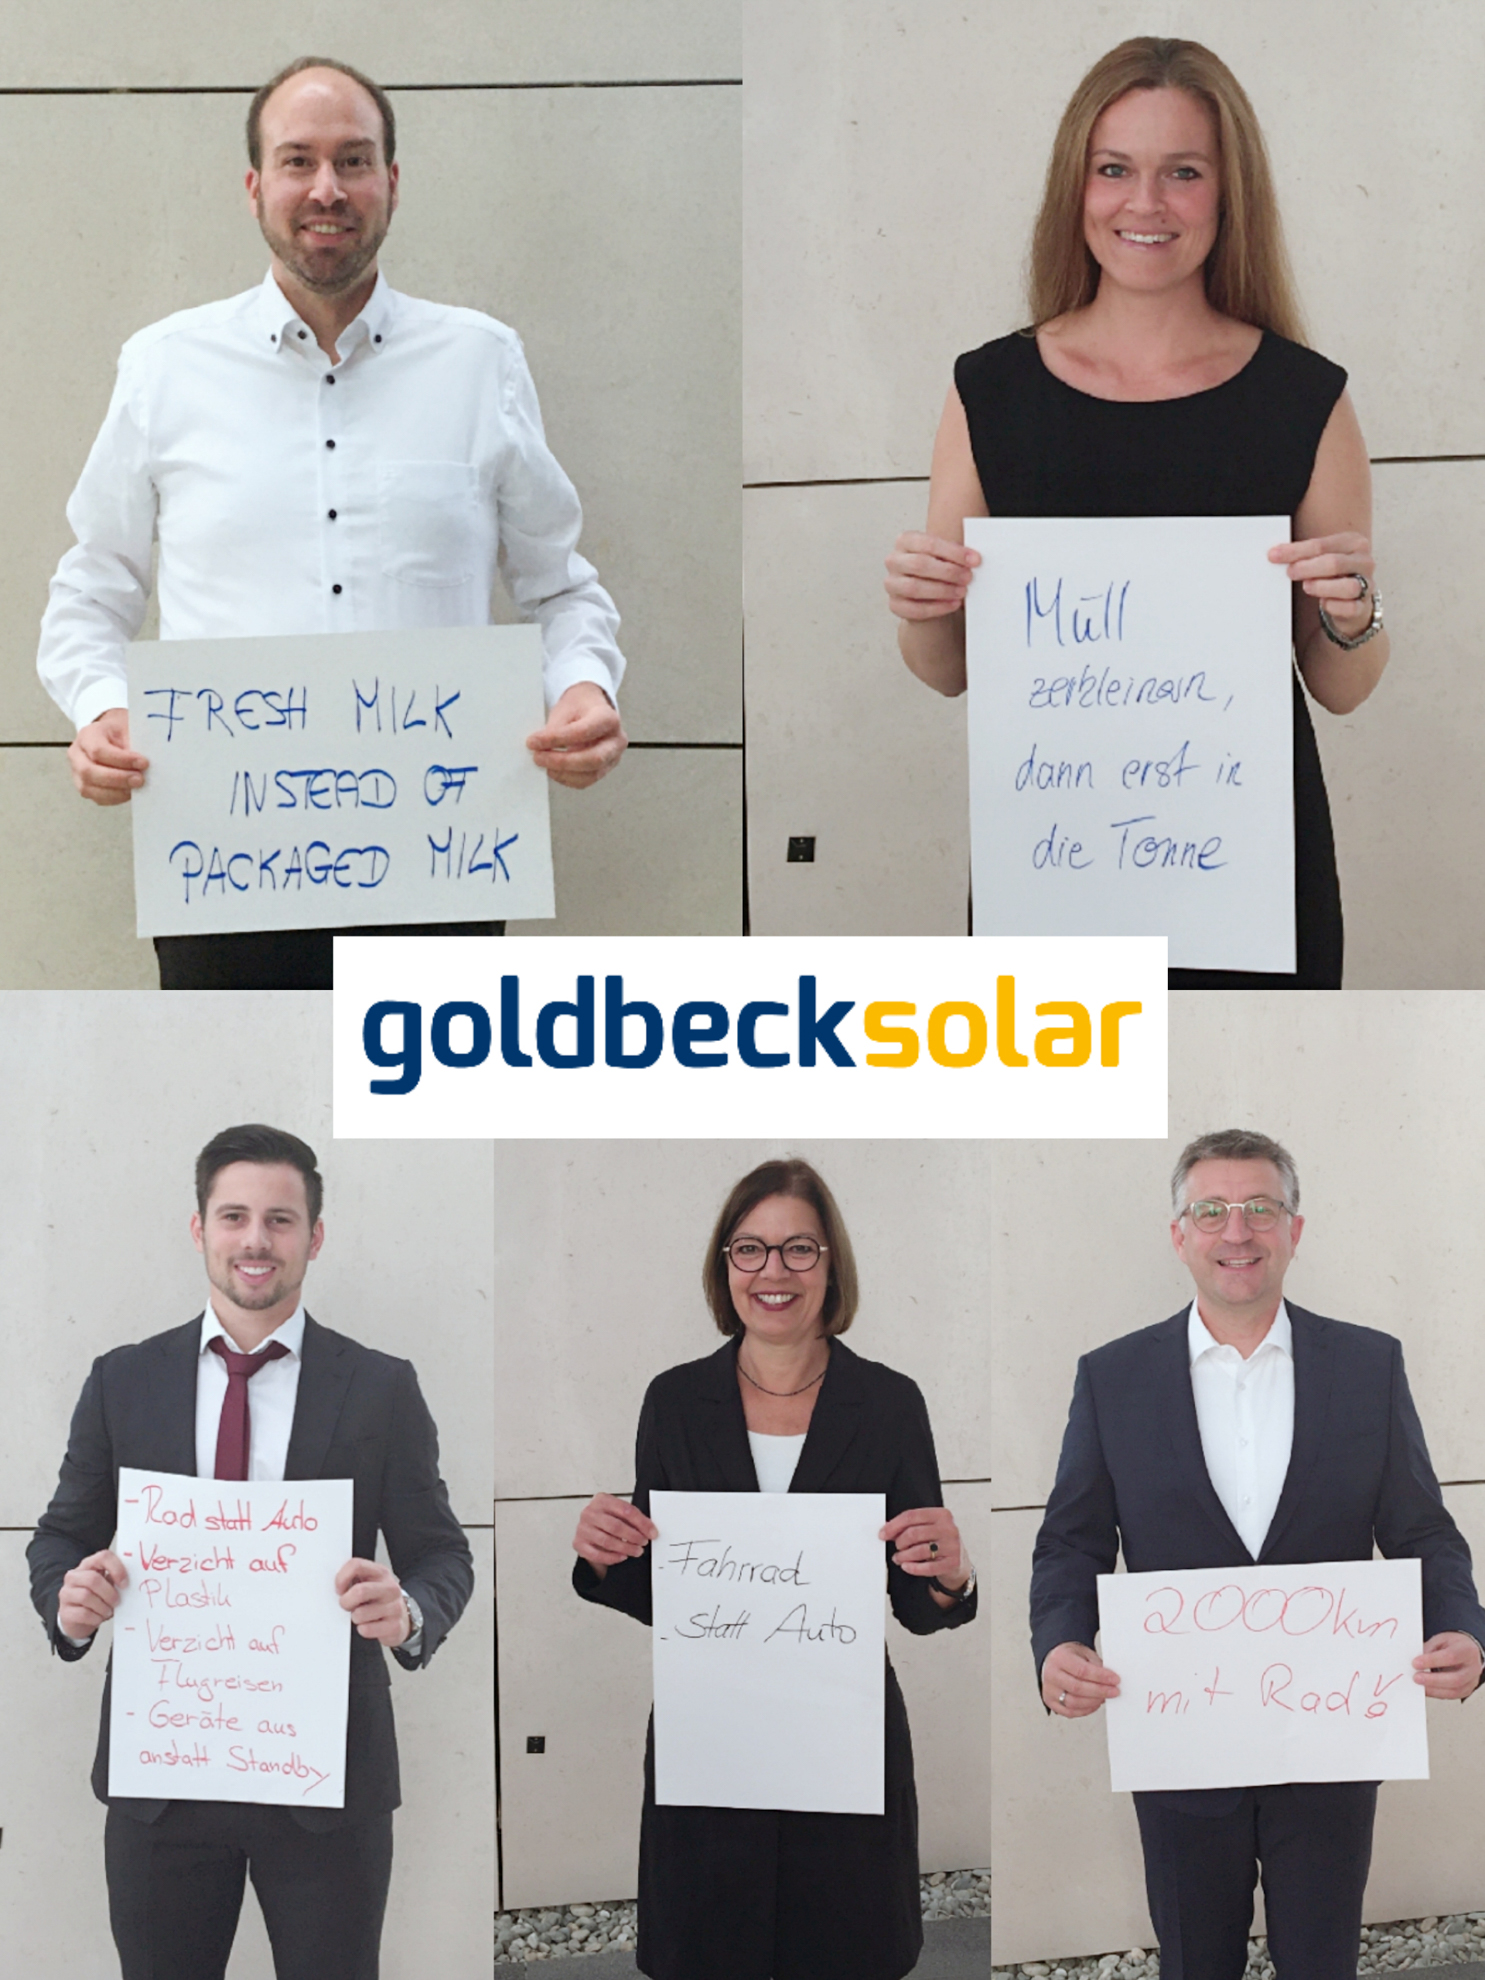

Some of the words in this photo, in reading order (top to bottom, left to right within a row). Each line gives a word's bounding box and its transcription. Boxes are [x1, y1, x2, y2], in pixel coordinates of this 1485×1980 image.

[1025, 576, 1130, 647] Müll
[144, 686, 307, 741] FRESH
[352, 676, 460, 738] MILK
[1015, 743, 1094, 791] dann
[1122, 740, 1200, 789] erst
[1215, 752, 1242, 788] in
[230, 769, 396, 816] INSTEAD
[424, 765, 478, 806] OF
[169, 840, 390, 904] PACKAGED
[427, 826, 518, 883] MILK
[1032, 823, 1094, 869] die
[1111, 815, 1228, 870] Tonne
[205, 1500, 252, 1531] statt
[261, 1499, 318, 1531] Auto
[249, 1543, 296, 1573] auf
[139, 1578, 232, 1608] Plastik
[146, 1618, 235, 1653] Verzicht
[248, 1625, 285, 1655] auf
[764, 1603, 857, 1644] Auto
[151, 1659, 283, 1702] Flugreisen
[1146, 1666, 1234, 1714] mit
[149, 1699, 242, 1731] Geräte
[257, 1721, 296, 1737] aus
[139, 1740, 211, 1767] anstatt
[227, 1745, 330, 1796] Standby
